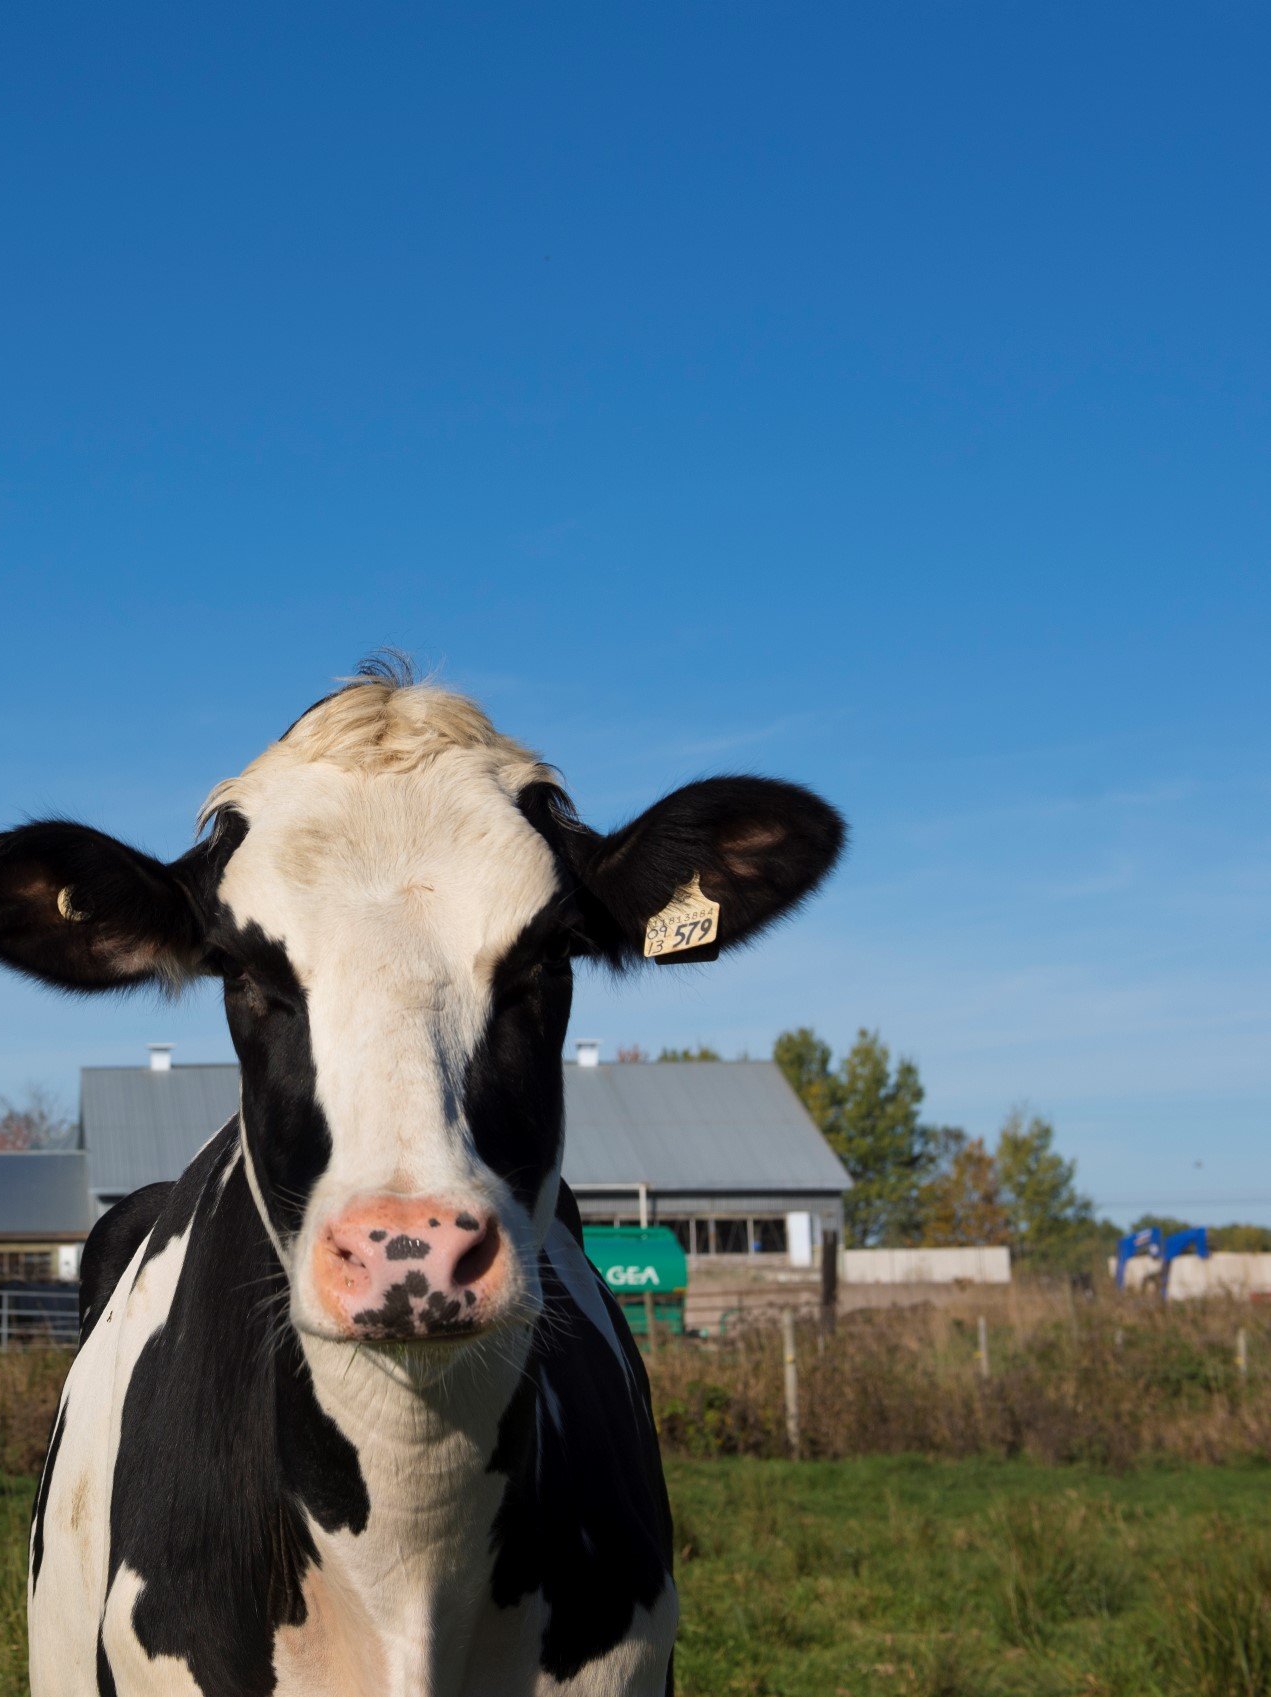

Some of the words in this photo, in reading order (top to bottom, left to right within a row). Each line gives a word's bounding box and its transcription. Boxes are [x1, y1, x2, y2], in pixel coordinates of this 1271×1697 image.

[673, 918, 712, 948] 579
[648, 940, 664, 955] 13
[606, 1265, 660, 1286] GEA
